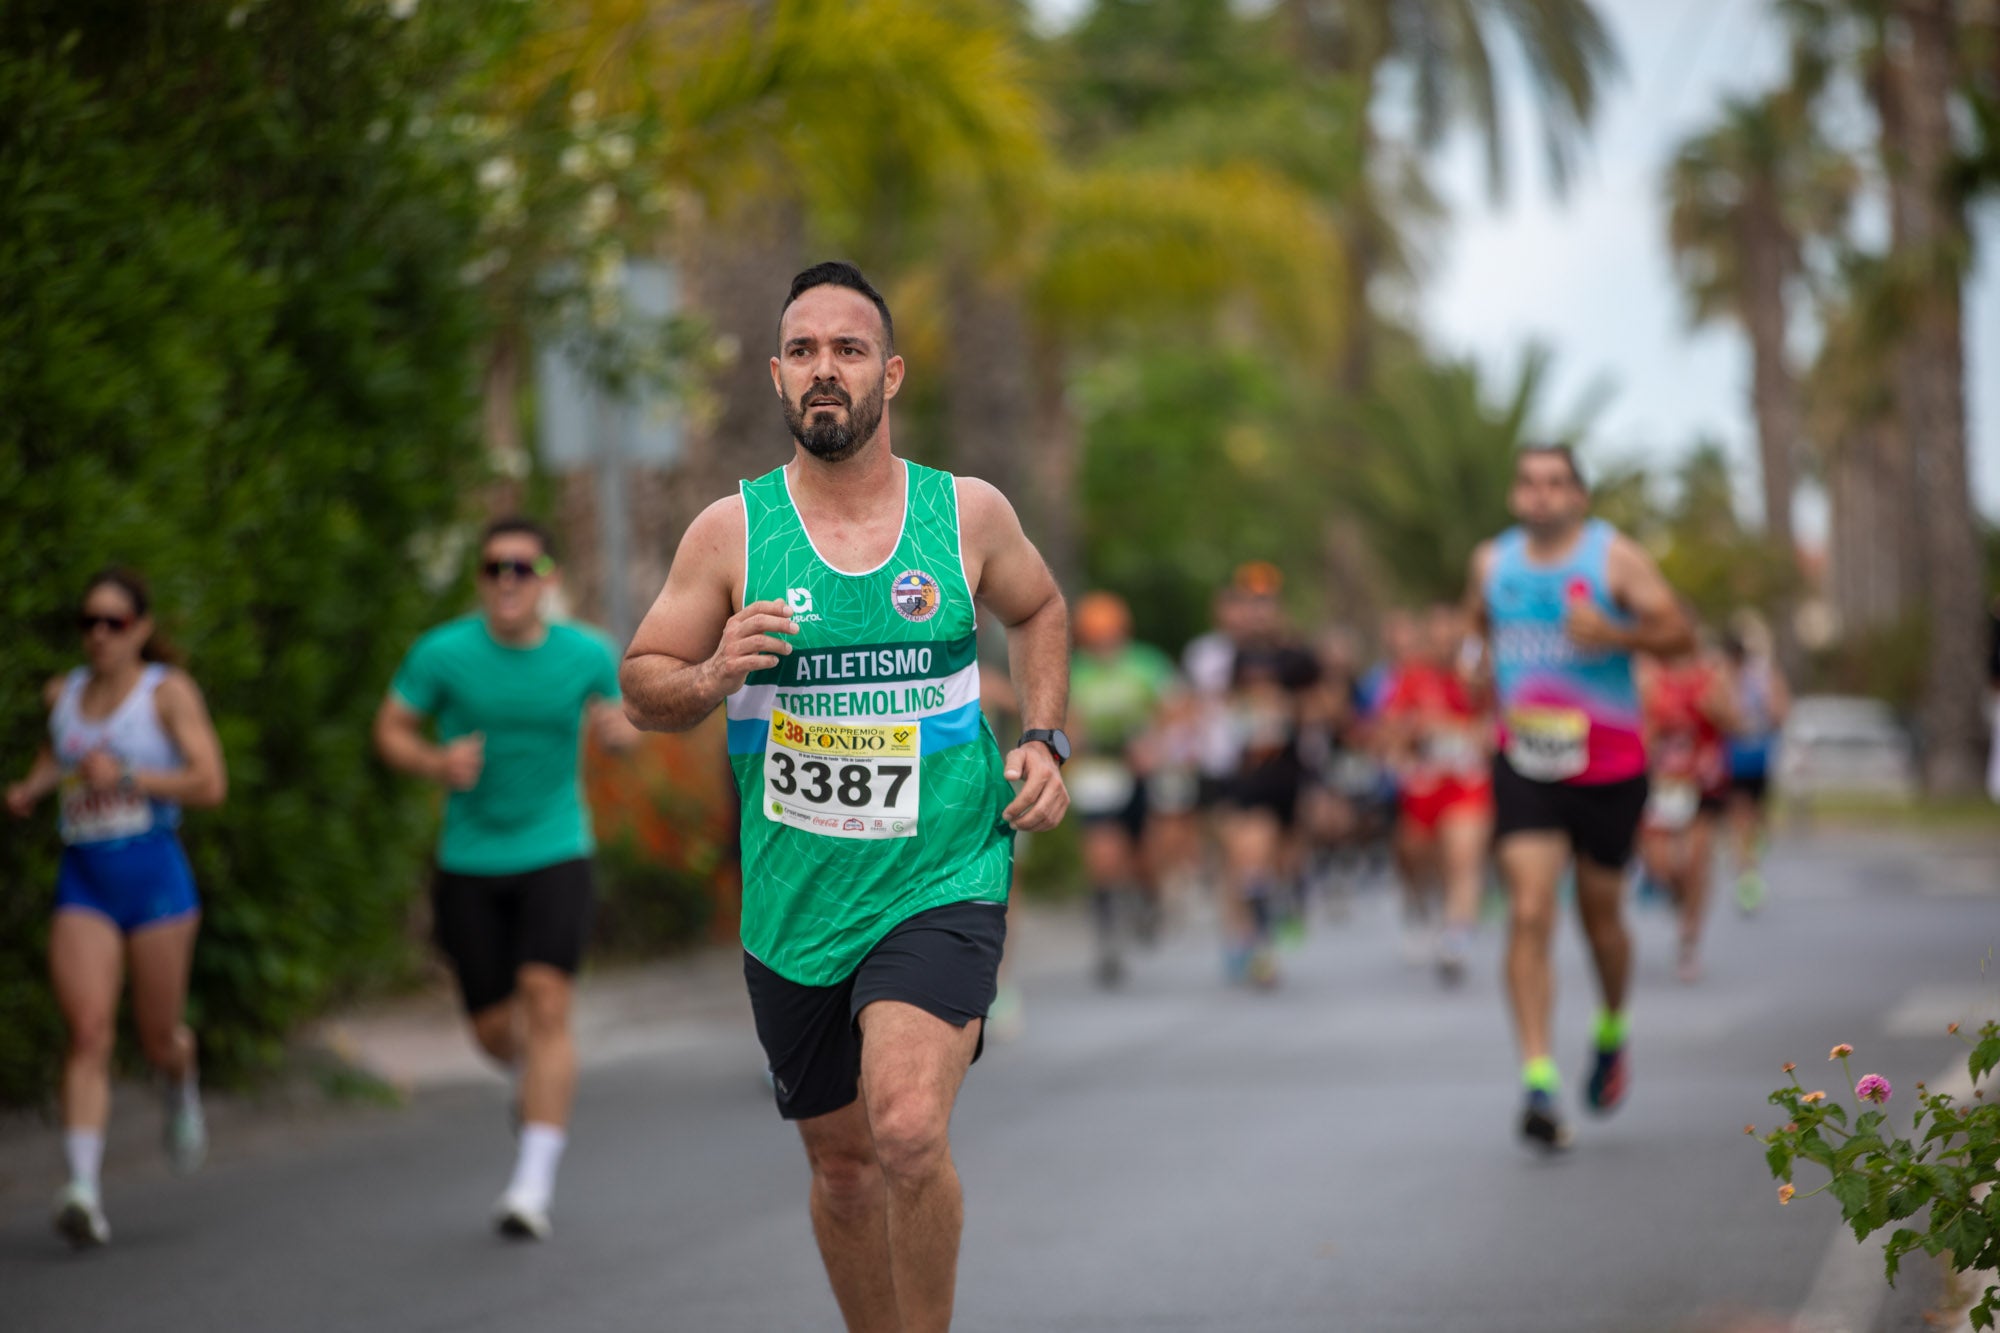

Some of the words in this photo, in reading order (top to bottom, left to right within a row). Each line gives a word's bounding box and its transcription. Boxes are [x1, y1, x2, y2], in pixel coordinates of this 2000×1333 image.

[796, 648, 932, 680] ATLETISMO
[775, 683, 945, 717] TORREMOLINOS
[784, 720, 804, 744] 38
[805, 732, 885, 751] FONDO
[808, 725, 838, 734] GRAN
[840, 727, 878, 736] PREMIO
[769, 752, 913, 808] 3387
